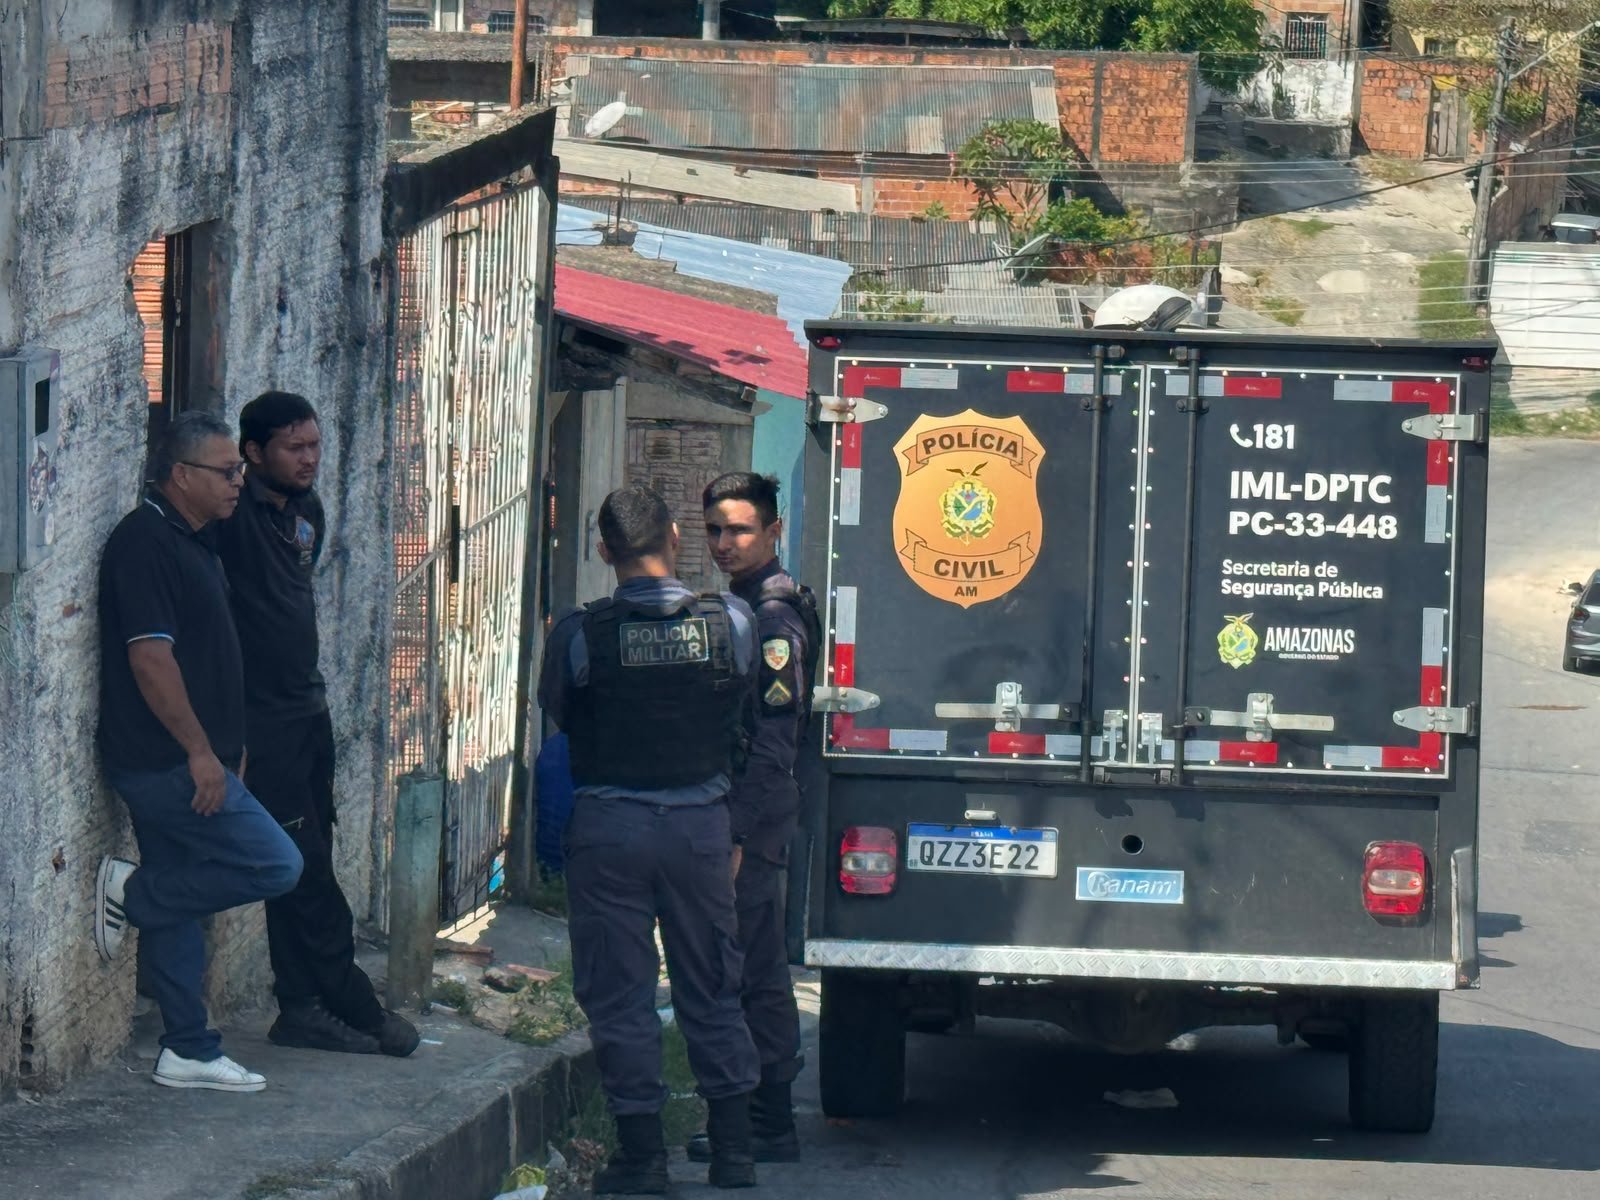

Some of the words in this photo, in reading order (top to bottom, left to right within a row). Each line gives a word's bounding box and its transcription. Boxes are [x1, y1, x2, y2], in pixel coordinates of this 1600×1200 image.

[922, 428, 1019, 458] POLÍCIA
[1253, 423, 1295, 450] 181
[1230, 470, 1392, 504] IML-DPTC
[1228, 511, 1398, 540] PC-33-448
[934, 558, 1004, 579] CIVIL
[1222, 559, 1310, 577] Secretaria
[1314, 561, 1339, 578] de
[954, 586, 978, 597] AM
[1221, 579, 1315, 601] Segurança
[1318, 581, 1384, 599] Pública
[628, 642, 702, 663] MILITAR
[1263, 626, 1356, 654] AMAZONAS
[919, 840, 1040, 871] QZZ3E22
